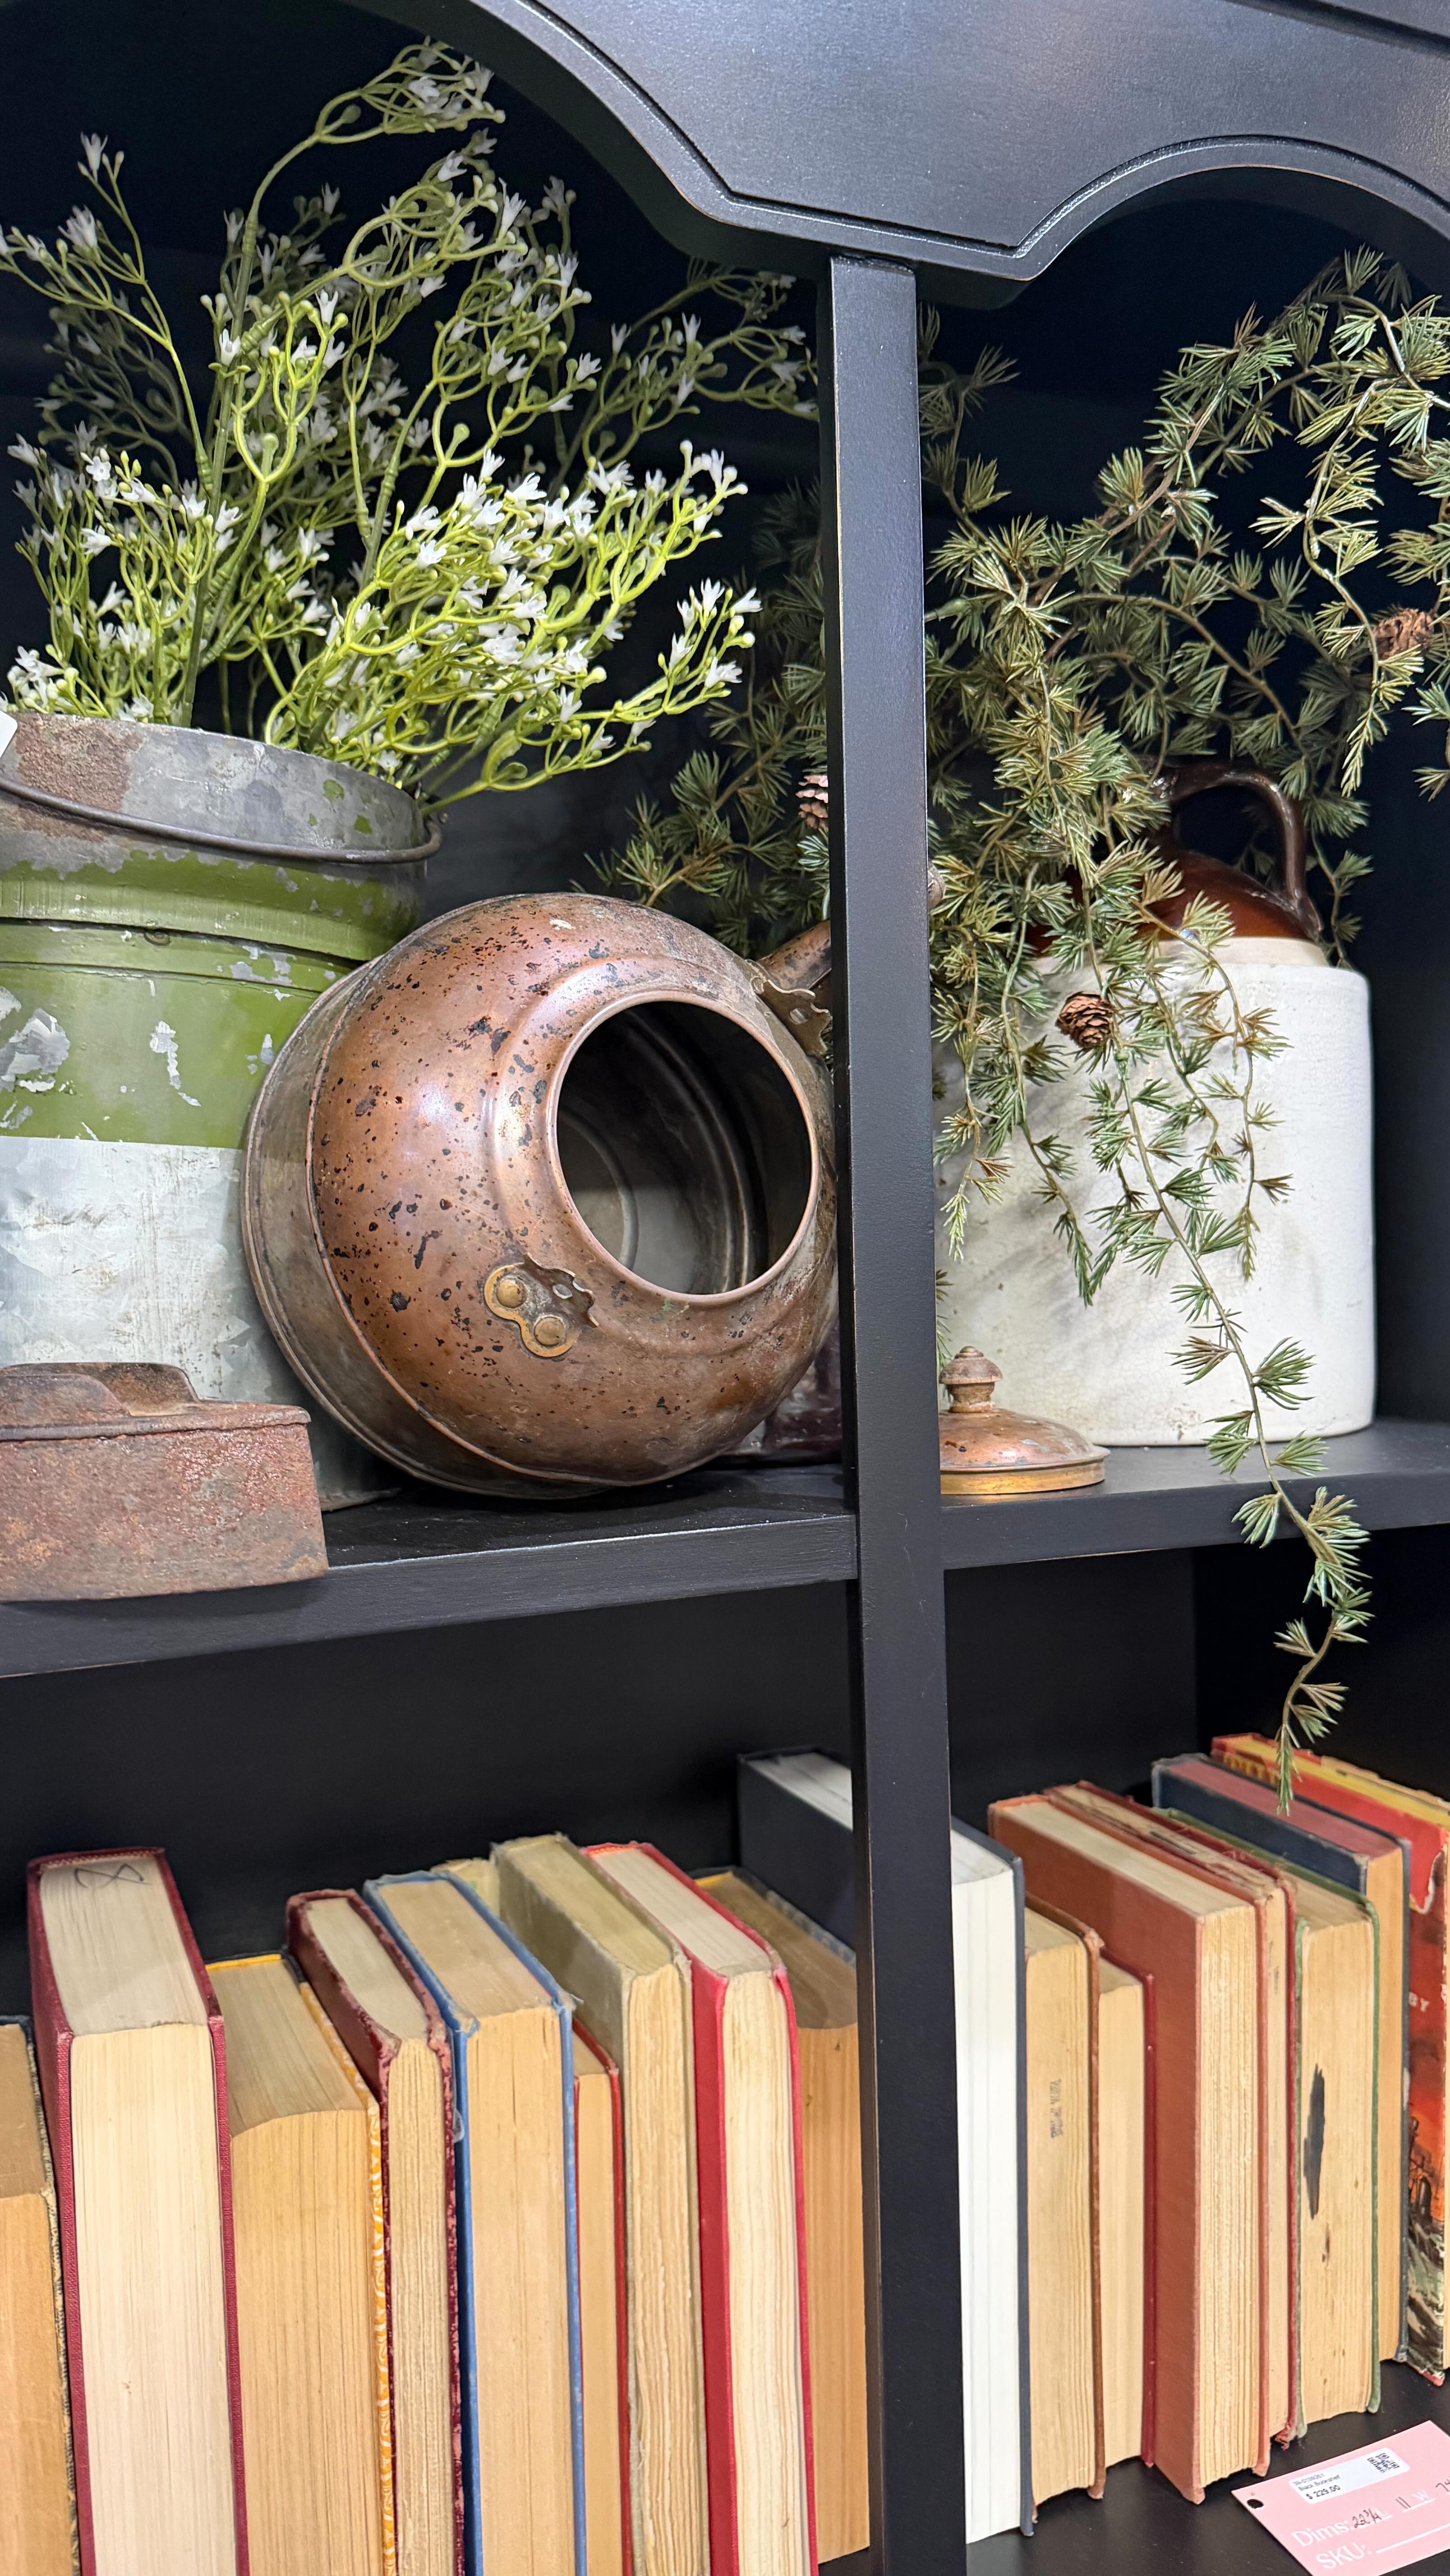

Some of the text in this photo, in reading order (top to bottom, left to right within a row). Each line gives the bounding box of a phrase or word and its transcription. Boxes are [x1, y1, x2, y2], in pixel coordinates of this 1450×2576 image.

[1313, 2485, 1341, 2498] 229.00
[1291, 2520, 1352, 2547] Dims:
[1316, 2542, 1372, 2569] SKU:
